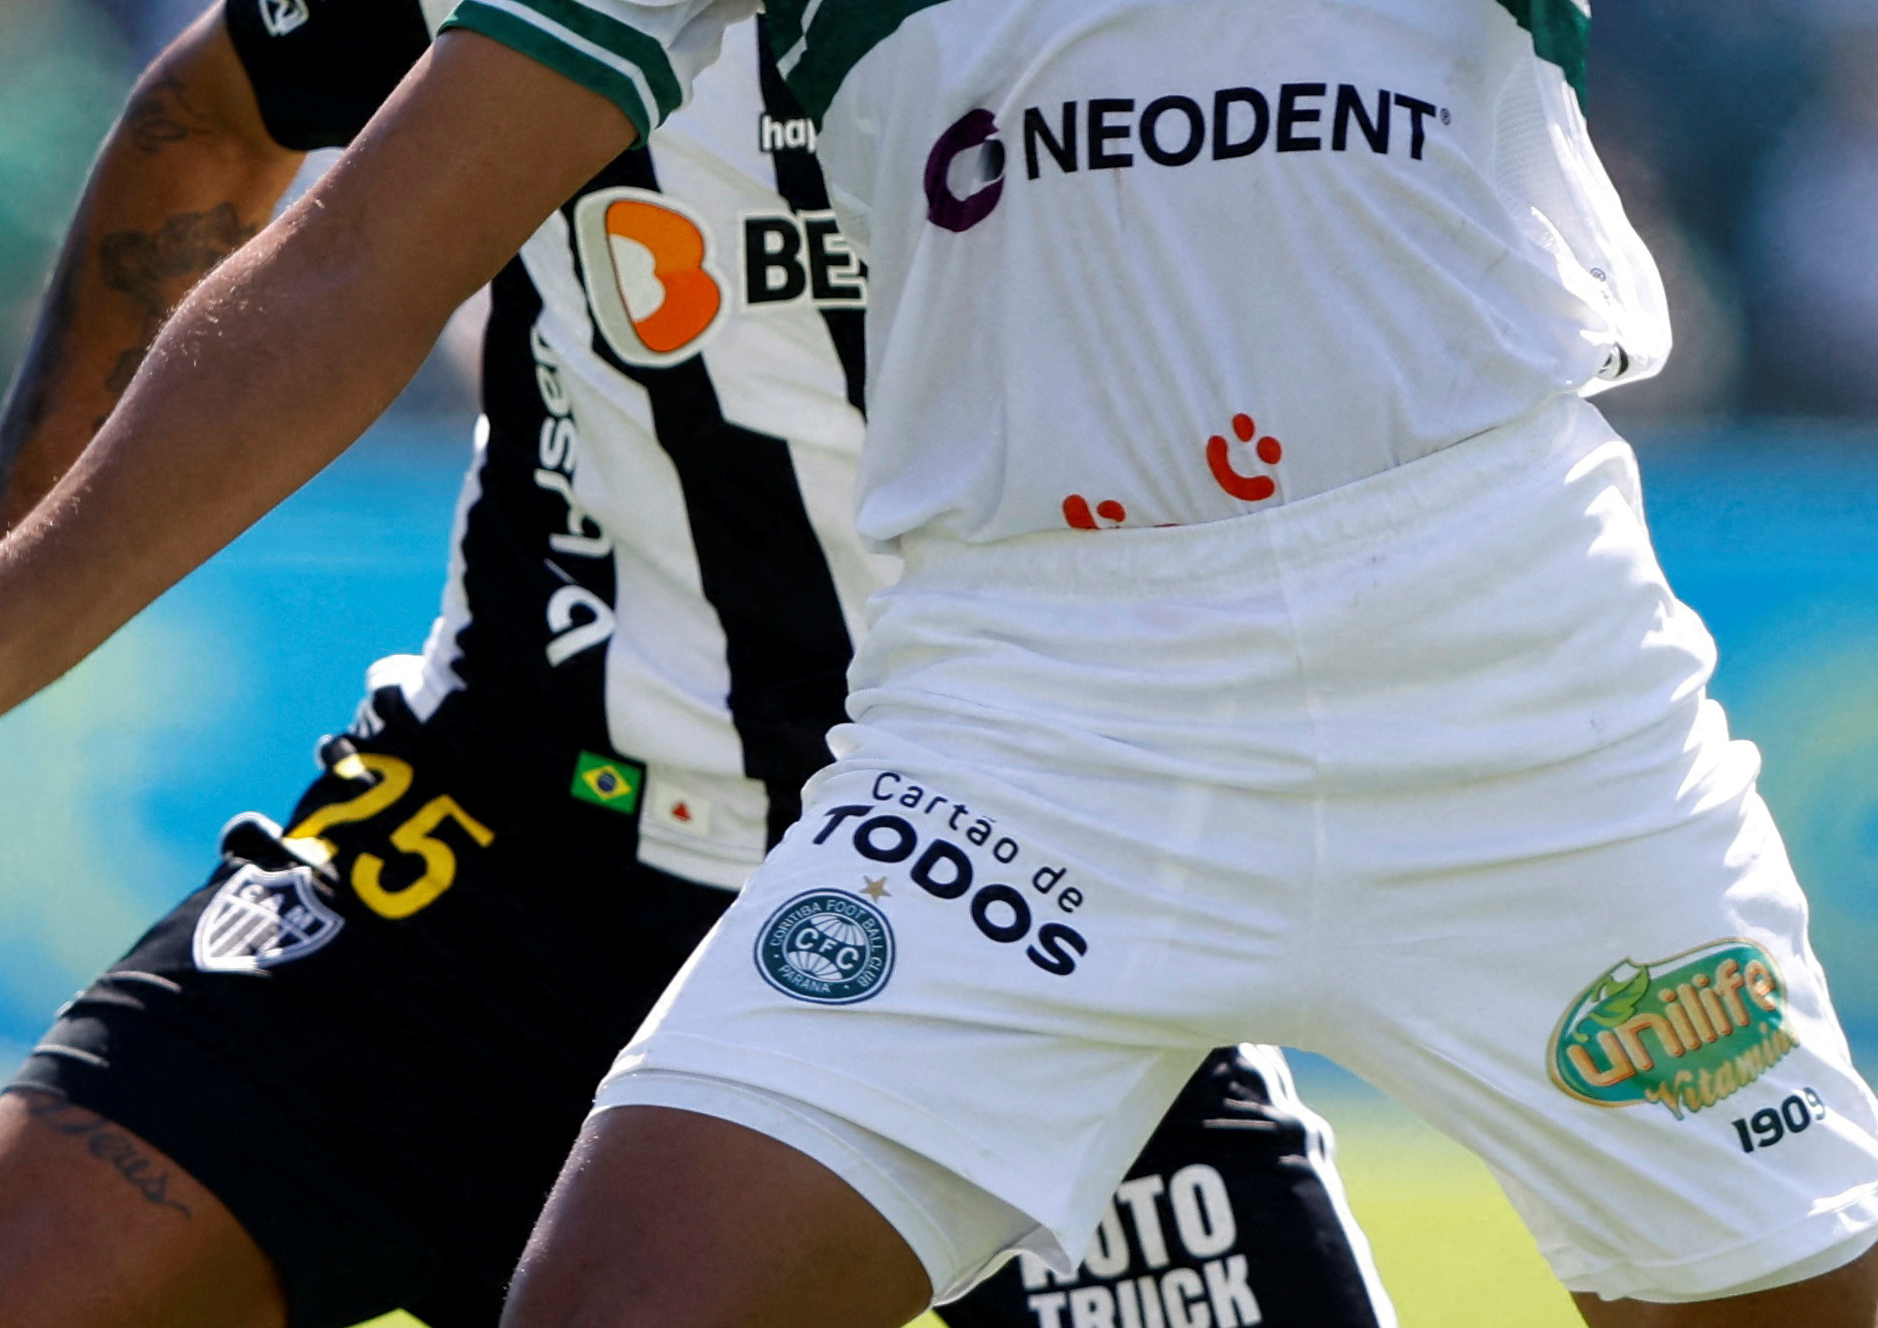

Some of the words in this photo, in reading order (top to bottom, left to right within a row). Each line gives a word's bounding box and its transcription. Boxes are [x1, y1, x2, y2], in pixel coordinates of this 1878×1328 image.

[1023, 82, 1437, 181] NEODENT
[282, 752, 496, 919] 25
[812, 804, 1088, 976] TODOS
[872, 772, 1020, 865] Cartão
[1032, 866, 1084, 914] de
[1565, 958, 1776, 1087] unilife
[1730, 1086, 1826, 1154] 1909
[1019, 1163, 1237, 1290] UTO
